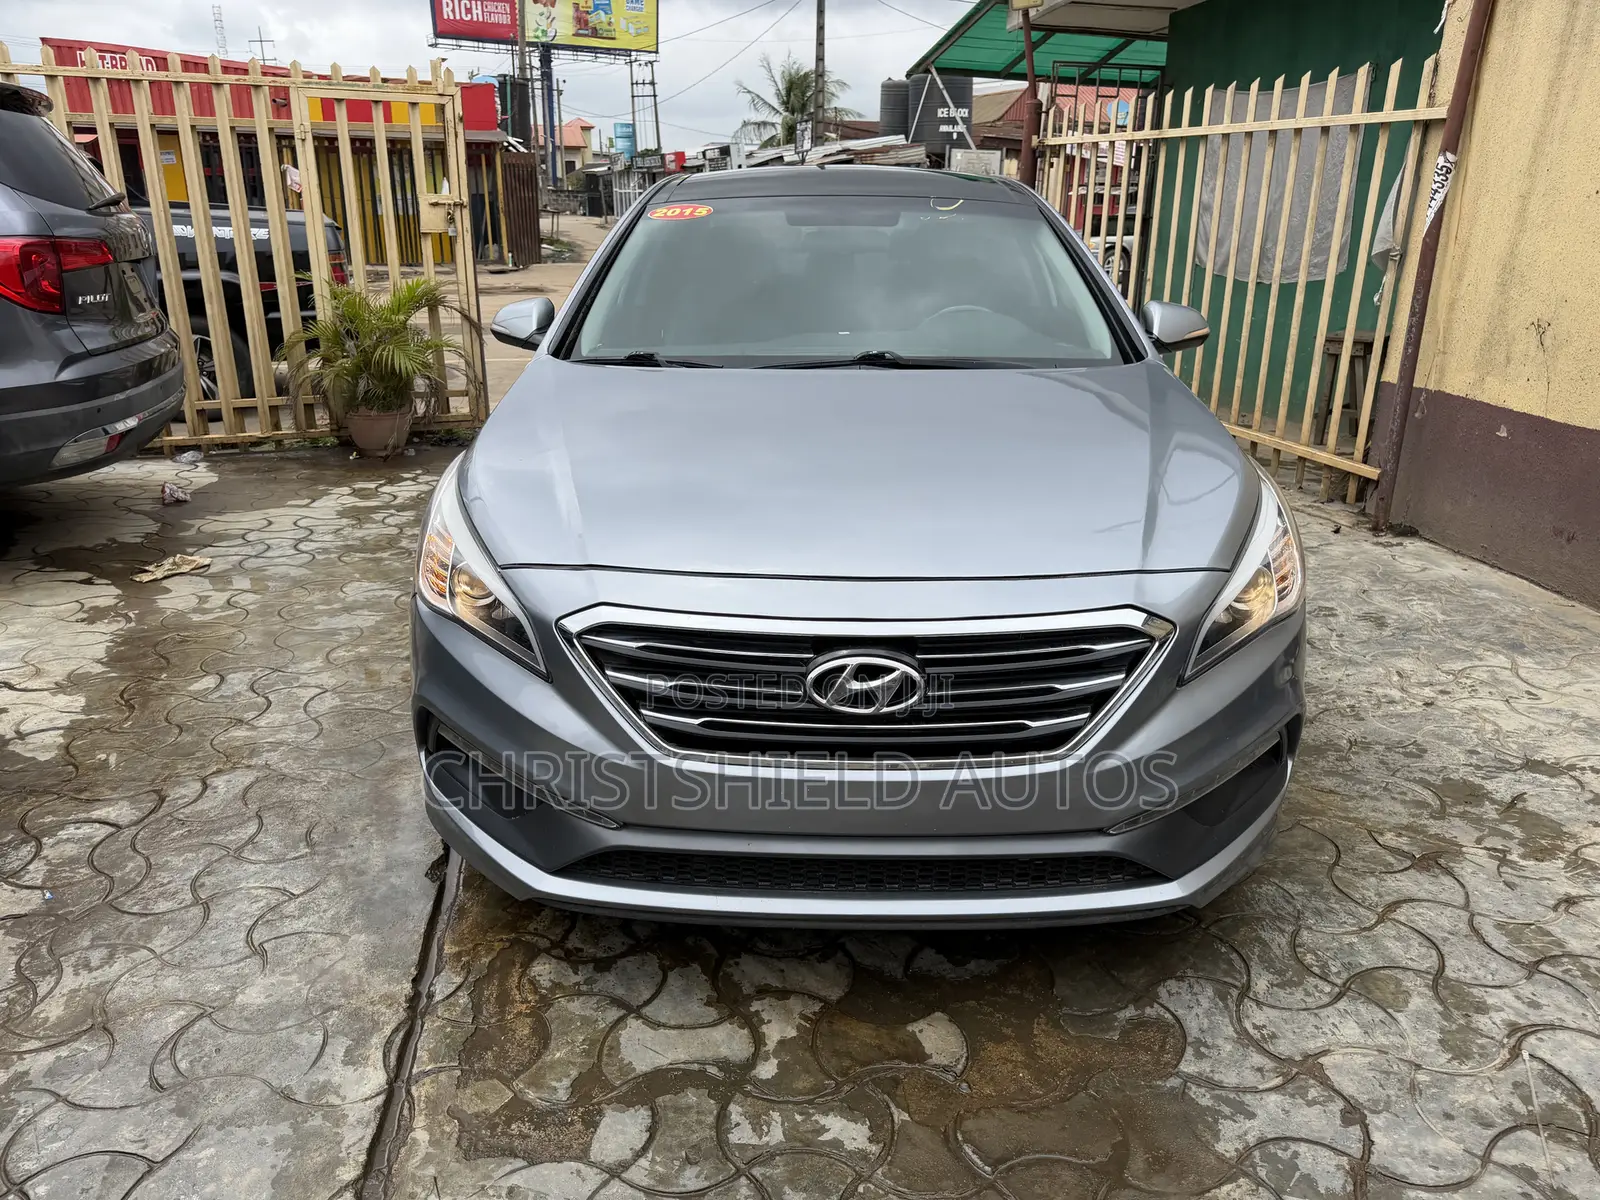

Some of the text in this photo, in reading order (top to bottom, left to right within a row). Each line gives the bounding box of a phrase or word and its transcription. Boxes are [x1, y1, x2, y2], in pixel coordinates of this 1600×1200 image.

[441, 0, 484, 21] RICH
[483, 1, 510, 13] CHICKEN
[483, 12, 511, 24] FLAVOUR
[937, 108, 969, 117] ICE BOCK
[652, 207, 710, 217] 2015
[78, 293, 111, 305] PILOT
